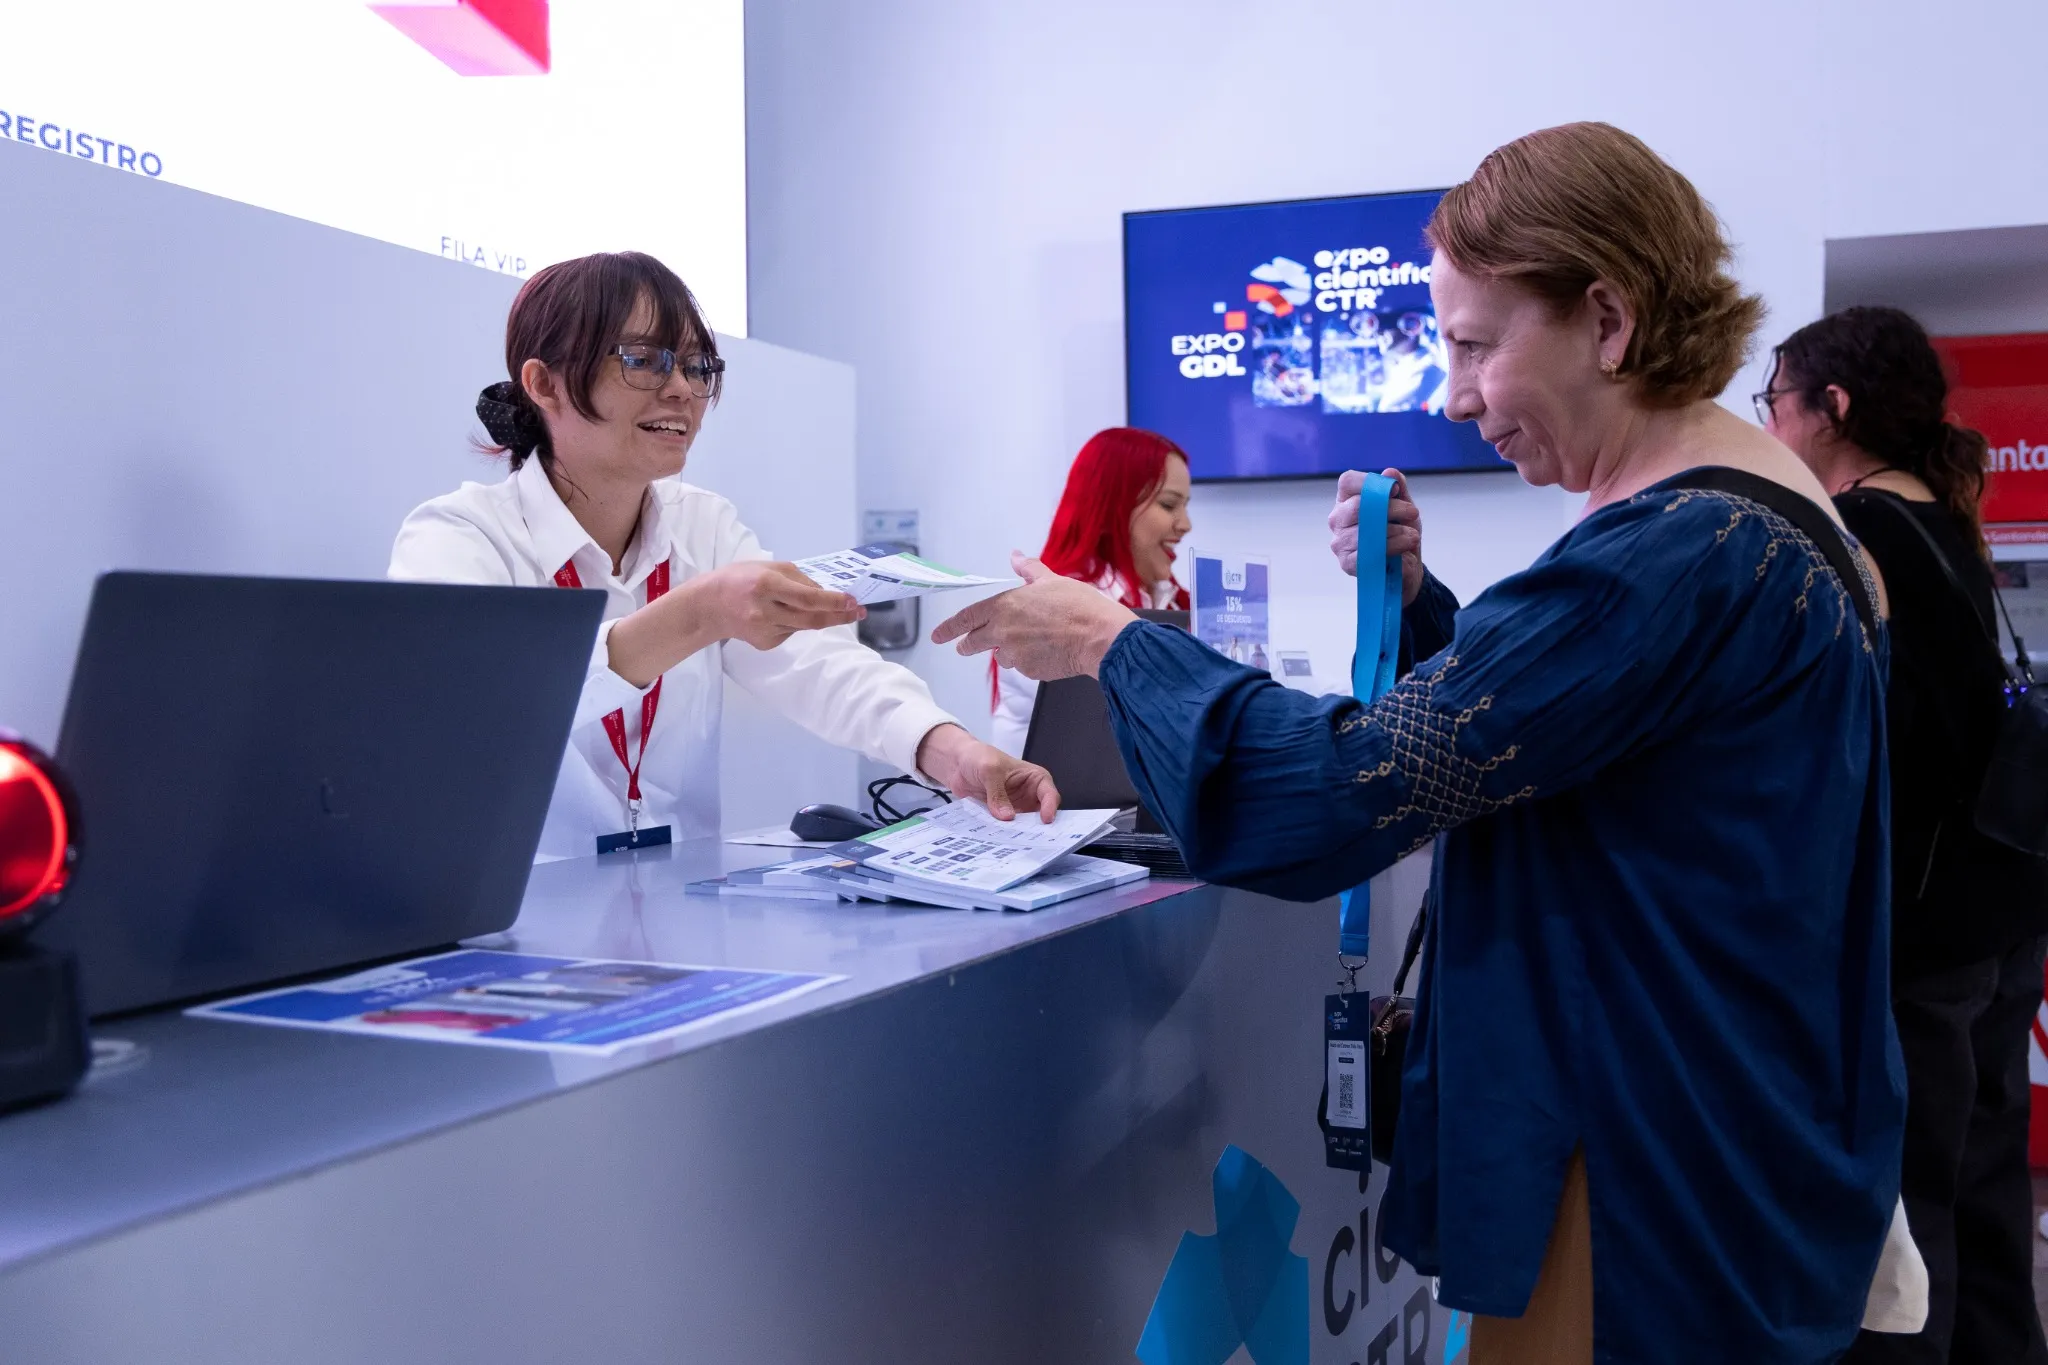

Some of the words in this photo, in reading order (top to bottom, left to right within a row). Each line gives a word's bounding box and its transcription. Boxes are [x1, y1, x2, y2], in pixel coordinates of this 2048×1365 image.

[0, 110, 162, 177] REGISTRO
[441, 236, 487, 267] FILA
[494, 249, 527, 272] VIP
[1314, 246, 1389, 270] expo
[1171, 332, 1245, 355] EXPO
[1179, 354, 1246, 379] GDL
[1225, 596, 1243, 612] 15%
[1216, 614, 1224, 623] DE
